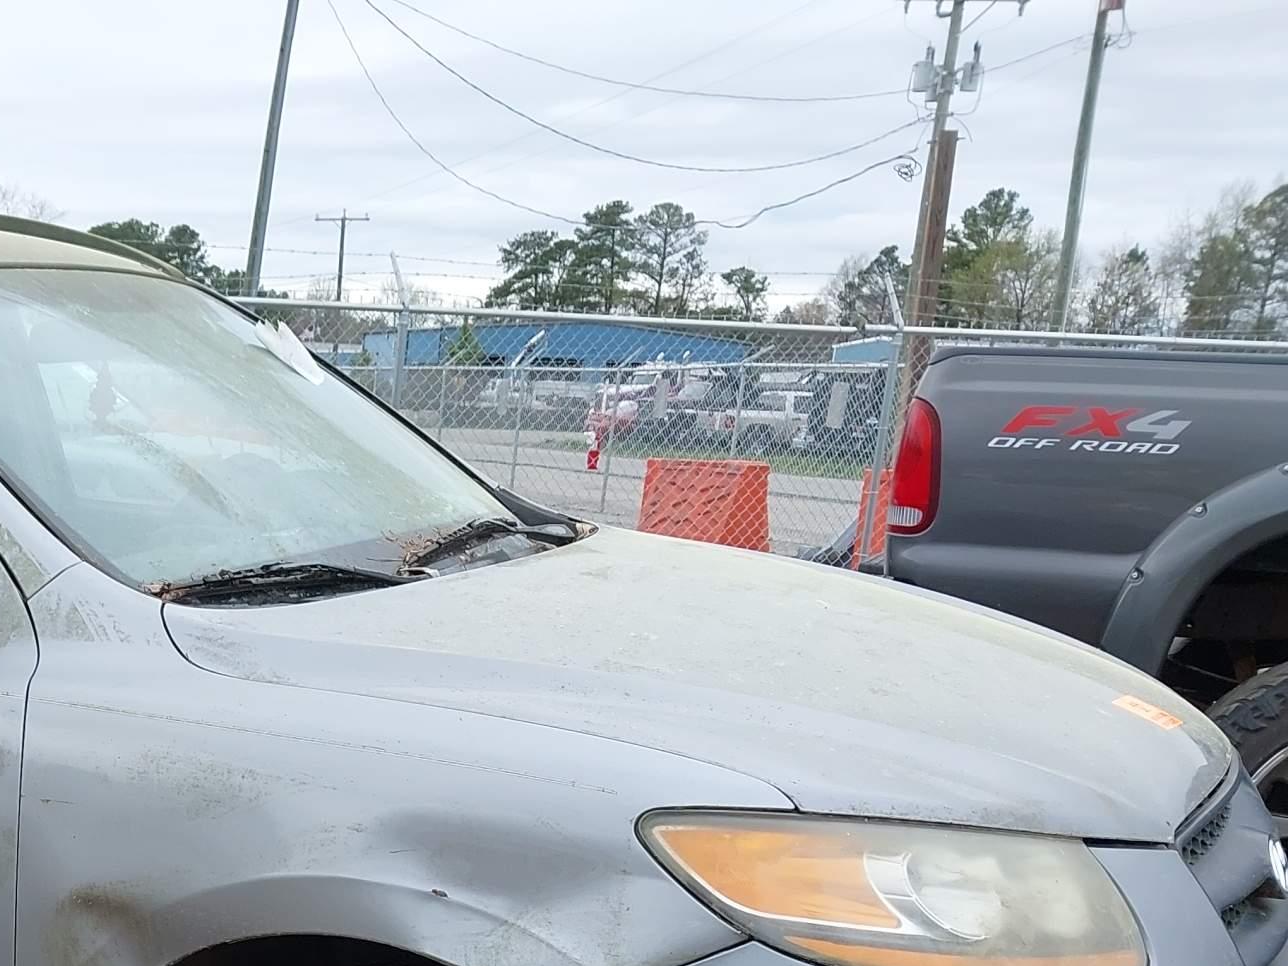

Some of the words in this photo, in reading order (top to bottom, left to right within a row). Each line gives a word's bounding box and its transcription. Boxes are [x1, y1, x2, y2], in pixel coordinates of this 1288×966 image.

[1001, 405, 1193, 440] FX4
[987, 436, 1061, 450] OFF
[1068, 438, 1181, 455] ROAD
